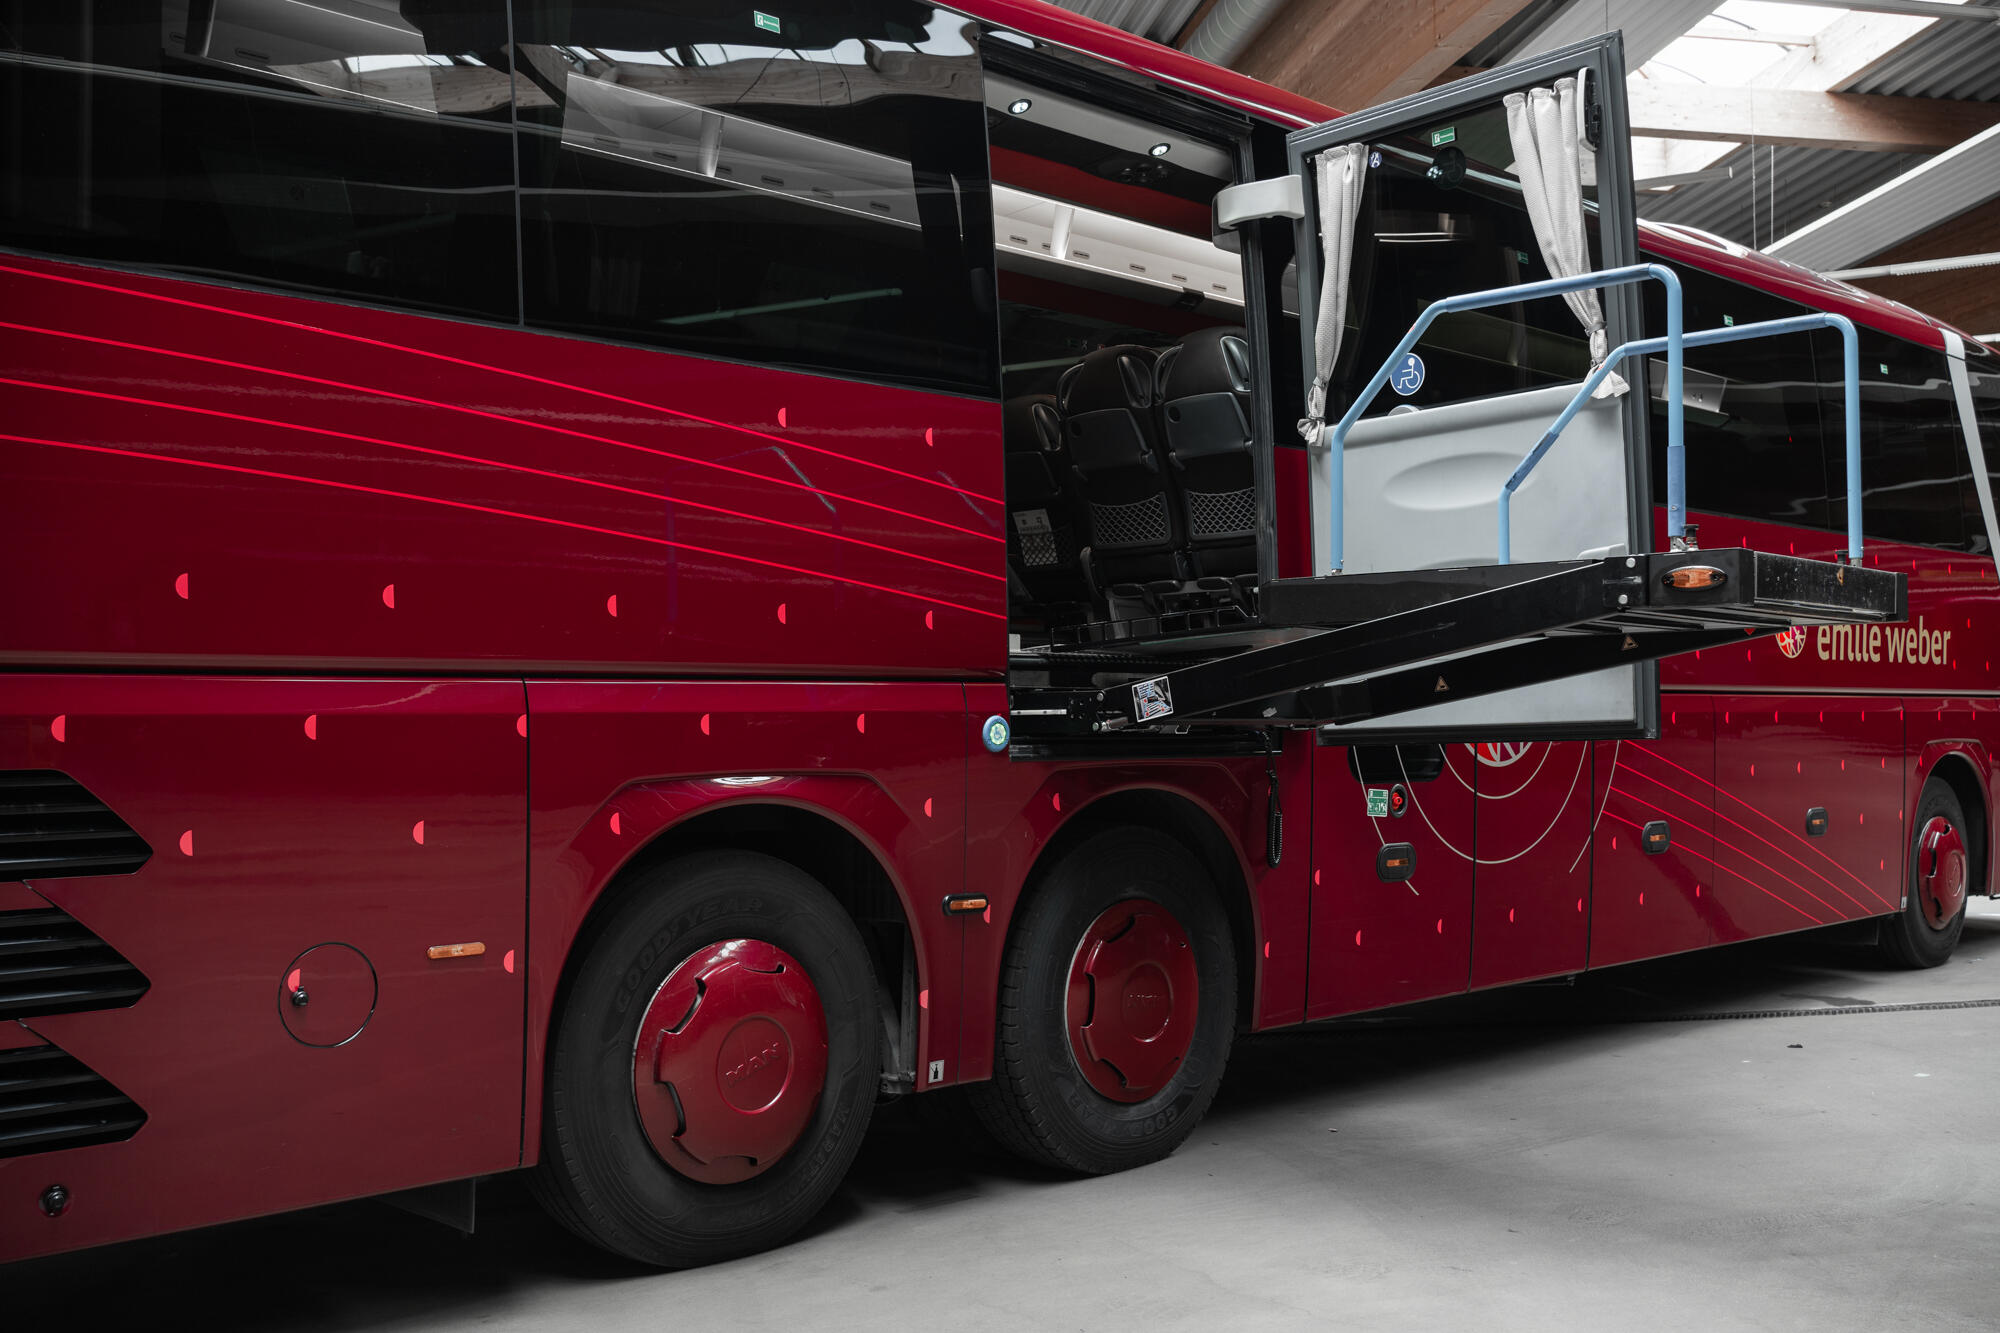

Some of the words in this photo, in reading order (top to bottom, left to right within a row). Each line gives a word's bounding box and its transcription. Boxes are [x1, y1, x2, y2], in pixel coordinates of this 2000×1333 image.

[1817, 623, 1881, 662] emile
[1885, 615, 1951, 665] weber
[725, 1041, 780, 1088] MAN
